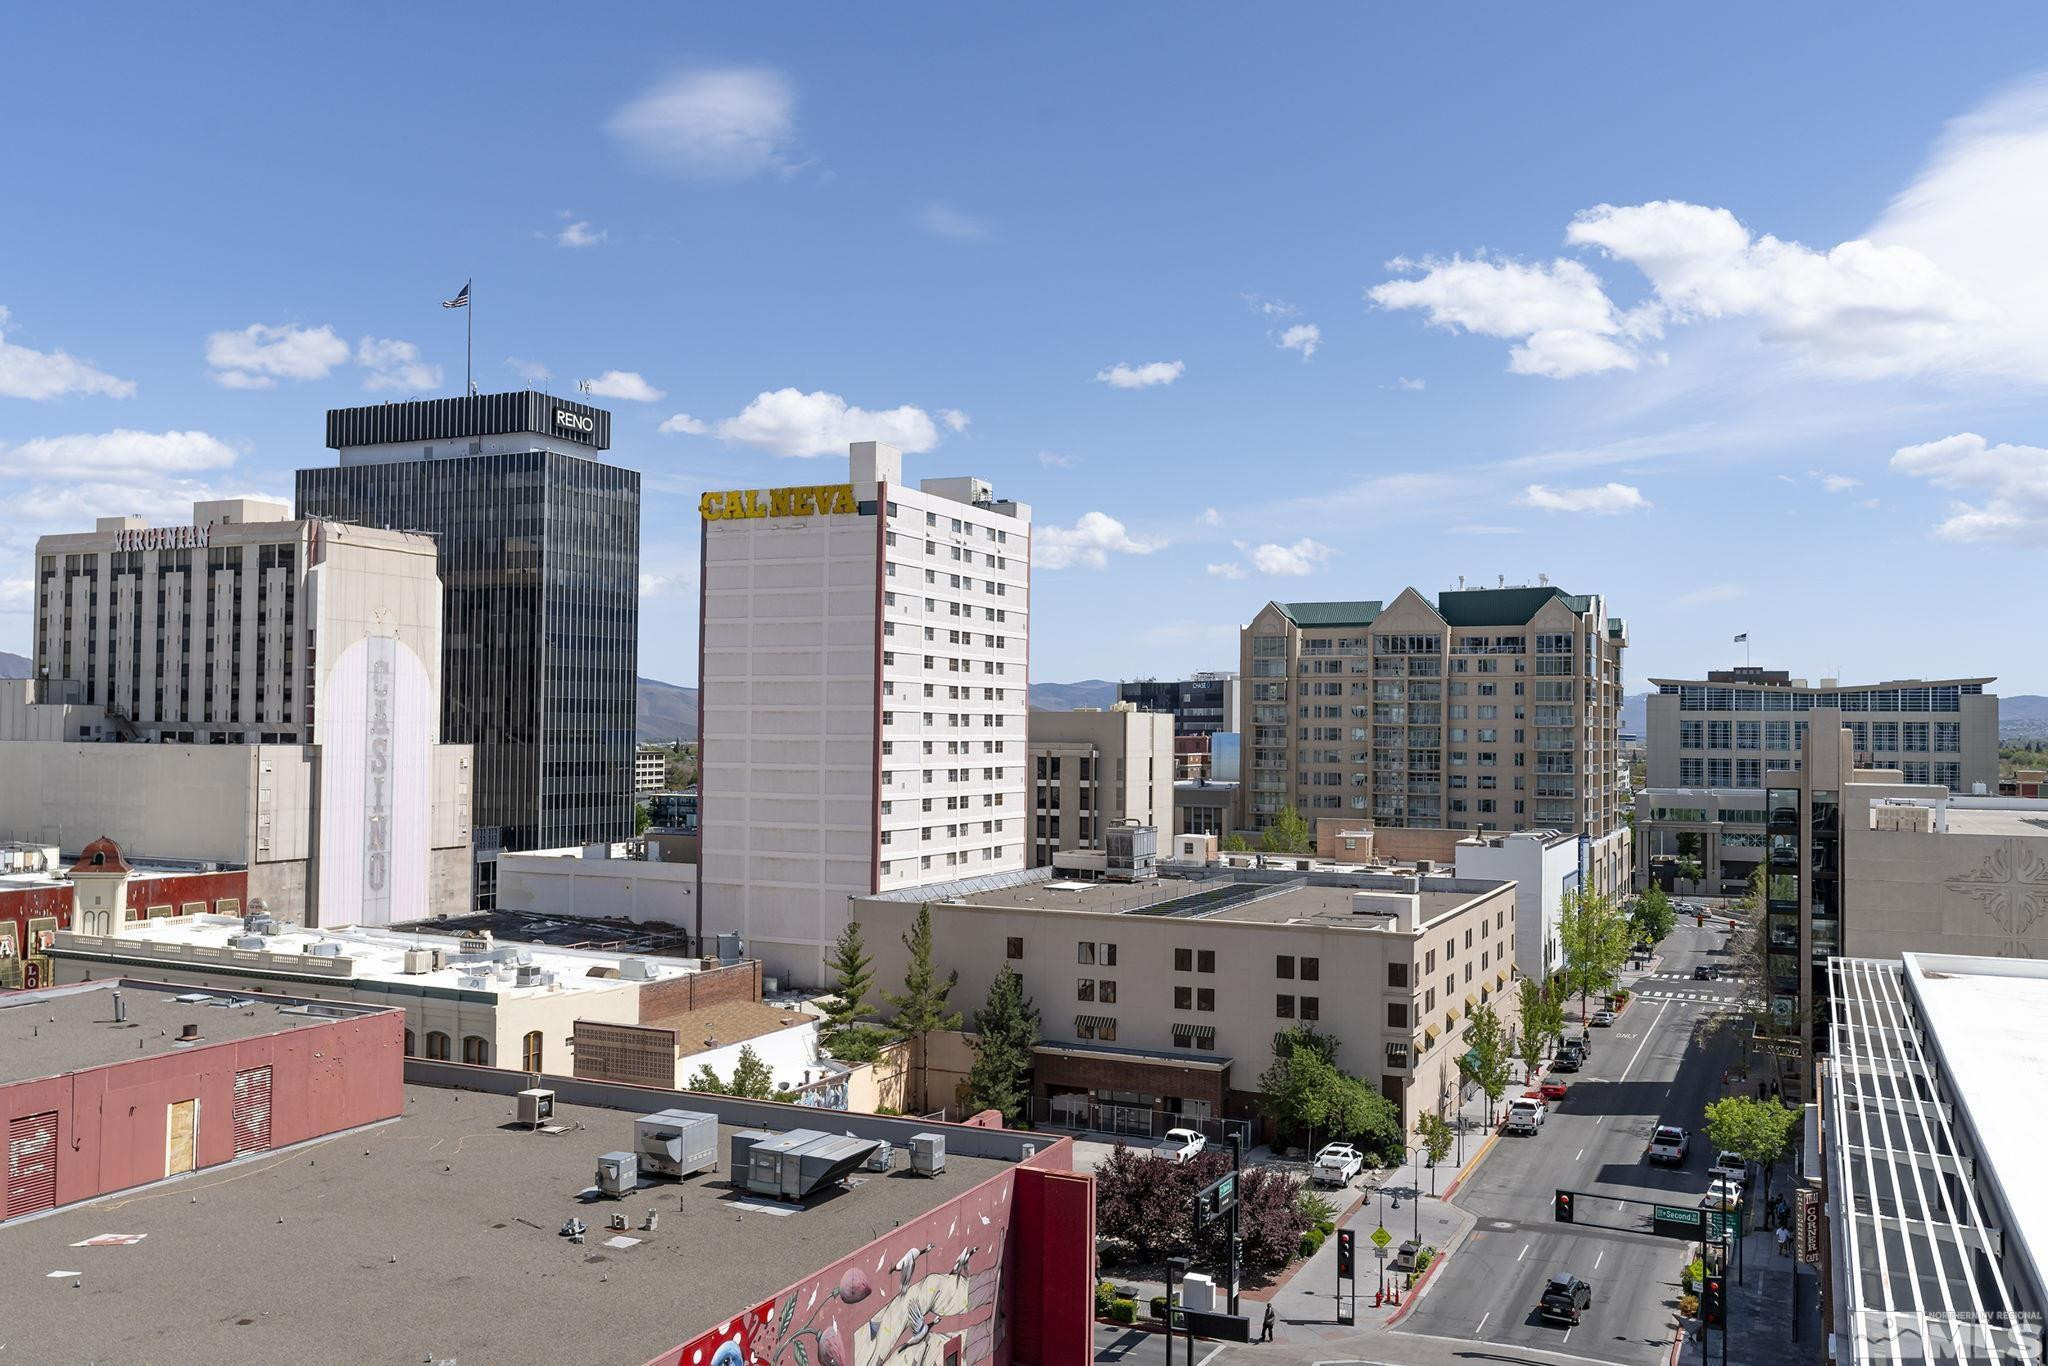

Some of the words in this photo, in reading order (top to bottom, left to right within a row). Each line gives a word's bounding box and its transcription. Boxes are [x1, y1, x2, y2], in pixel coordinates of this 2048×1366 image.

[557, 410, 593, 432] RENO
[701, 490, 767, 521] CAL
[770, 484, 858, 517] NEVA
[114, 525, 211, 552] VIRGINIAN
[369, 658, 390, 891] CASINO
[1666, 1210, 1692, 1221] Second
[1807, 1207, 1818, 1252] CORNER
